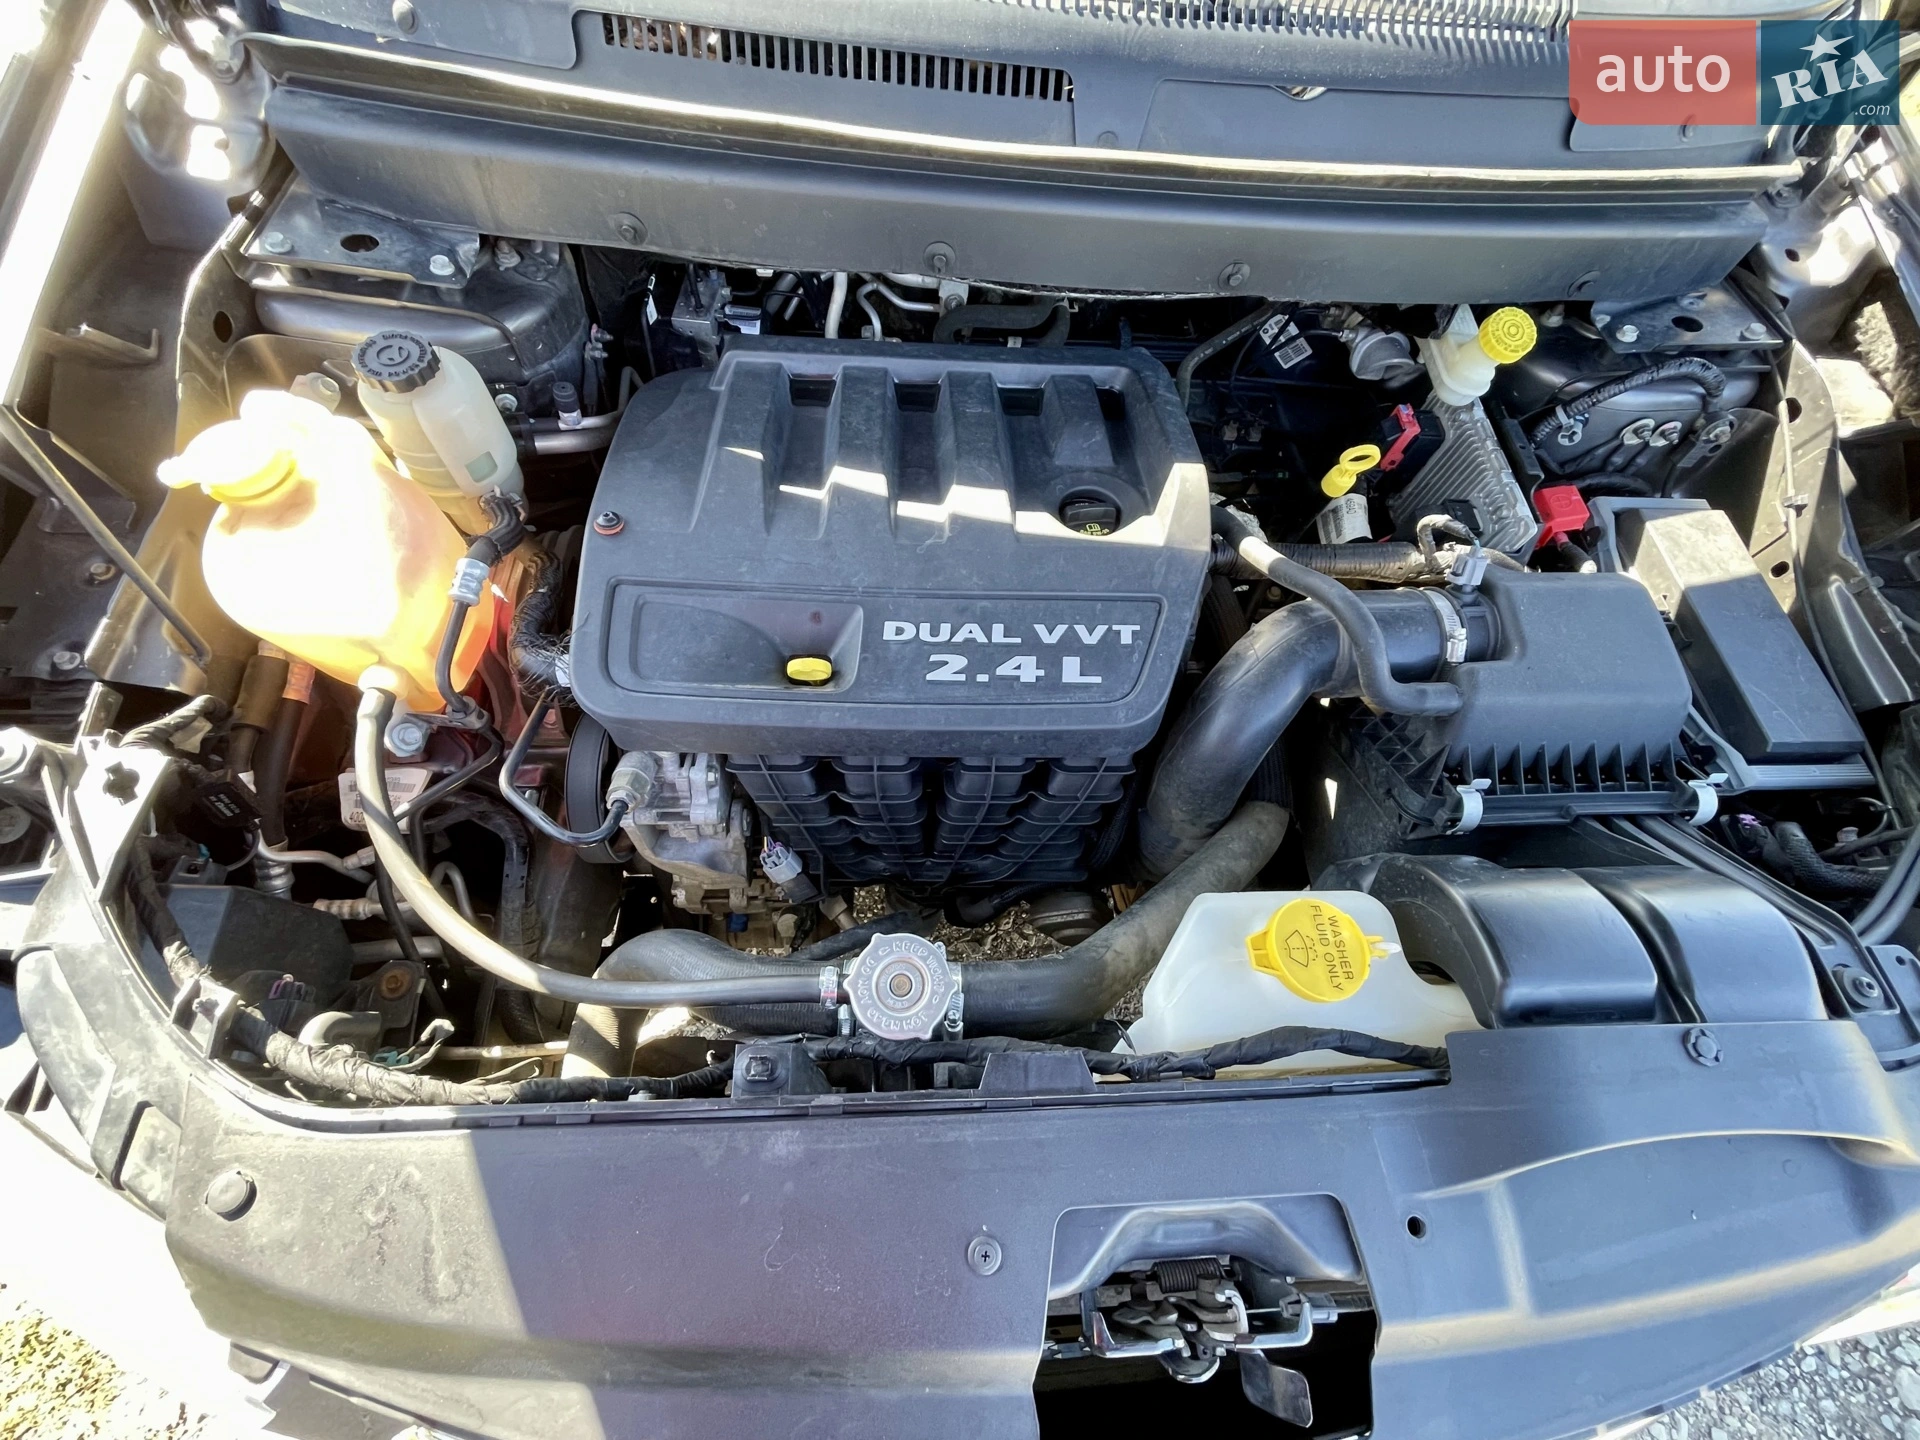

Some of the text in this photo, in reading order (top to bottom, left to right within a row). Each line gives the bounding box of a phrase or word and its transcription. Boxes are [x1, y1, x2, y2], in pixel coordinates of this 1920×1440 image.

[882, 621, 1141, 645] DUAL VVT
[925, 654, 1046, 683] 2.4
[893, 941, 928, 956] KEEP
[1310, 905, 1344, 991] FLUID ONLY
[1327, 915, 1354, 980] WASHER
